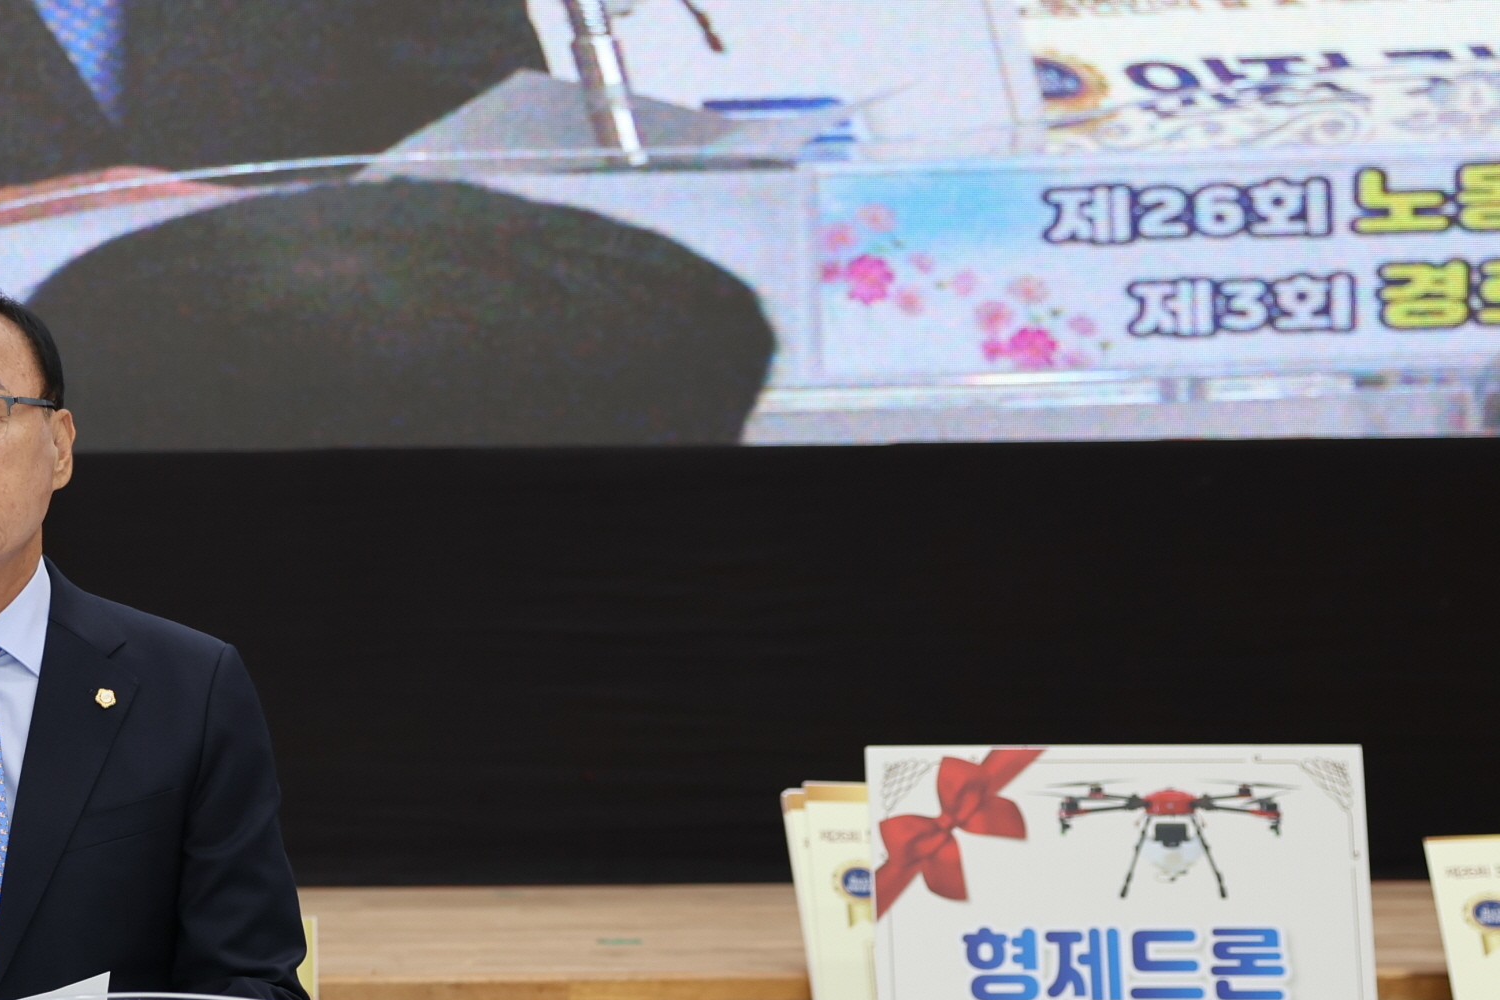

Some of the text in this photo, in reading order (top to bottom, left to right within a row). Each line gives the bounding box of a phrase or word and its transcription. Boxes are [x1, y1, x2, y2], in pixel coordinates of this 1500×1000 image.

[1043, 176, 1333, 243] 제26회
[1126, 258, 1500, 337] 제3회 경
